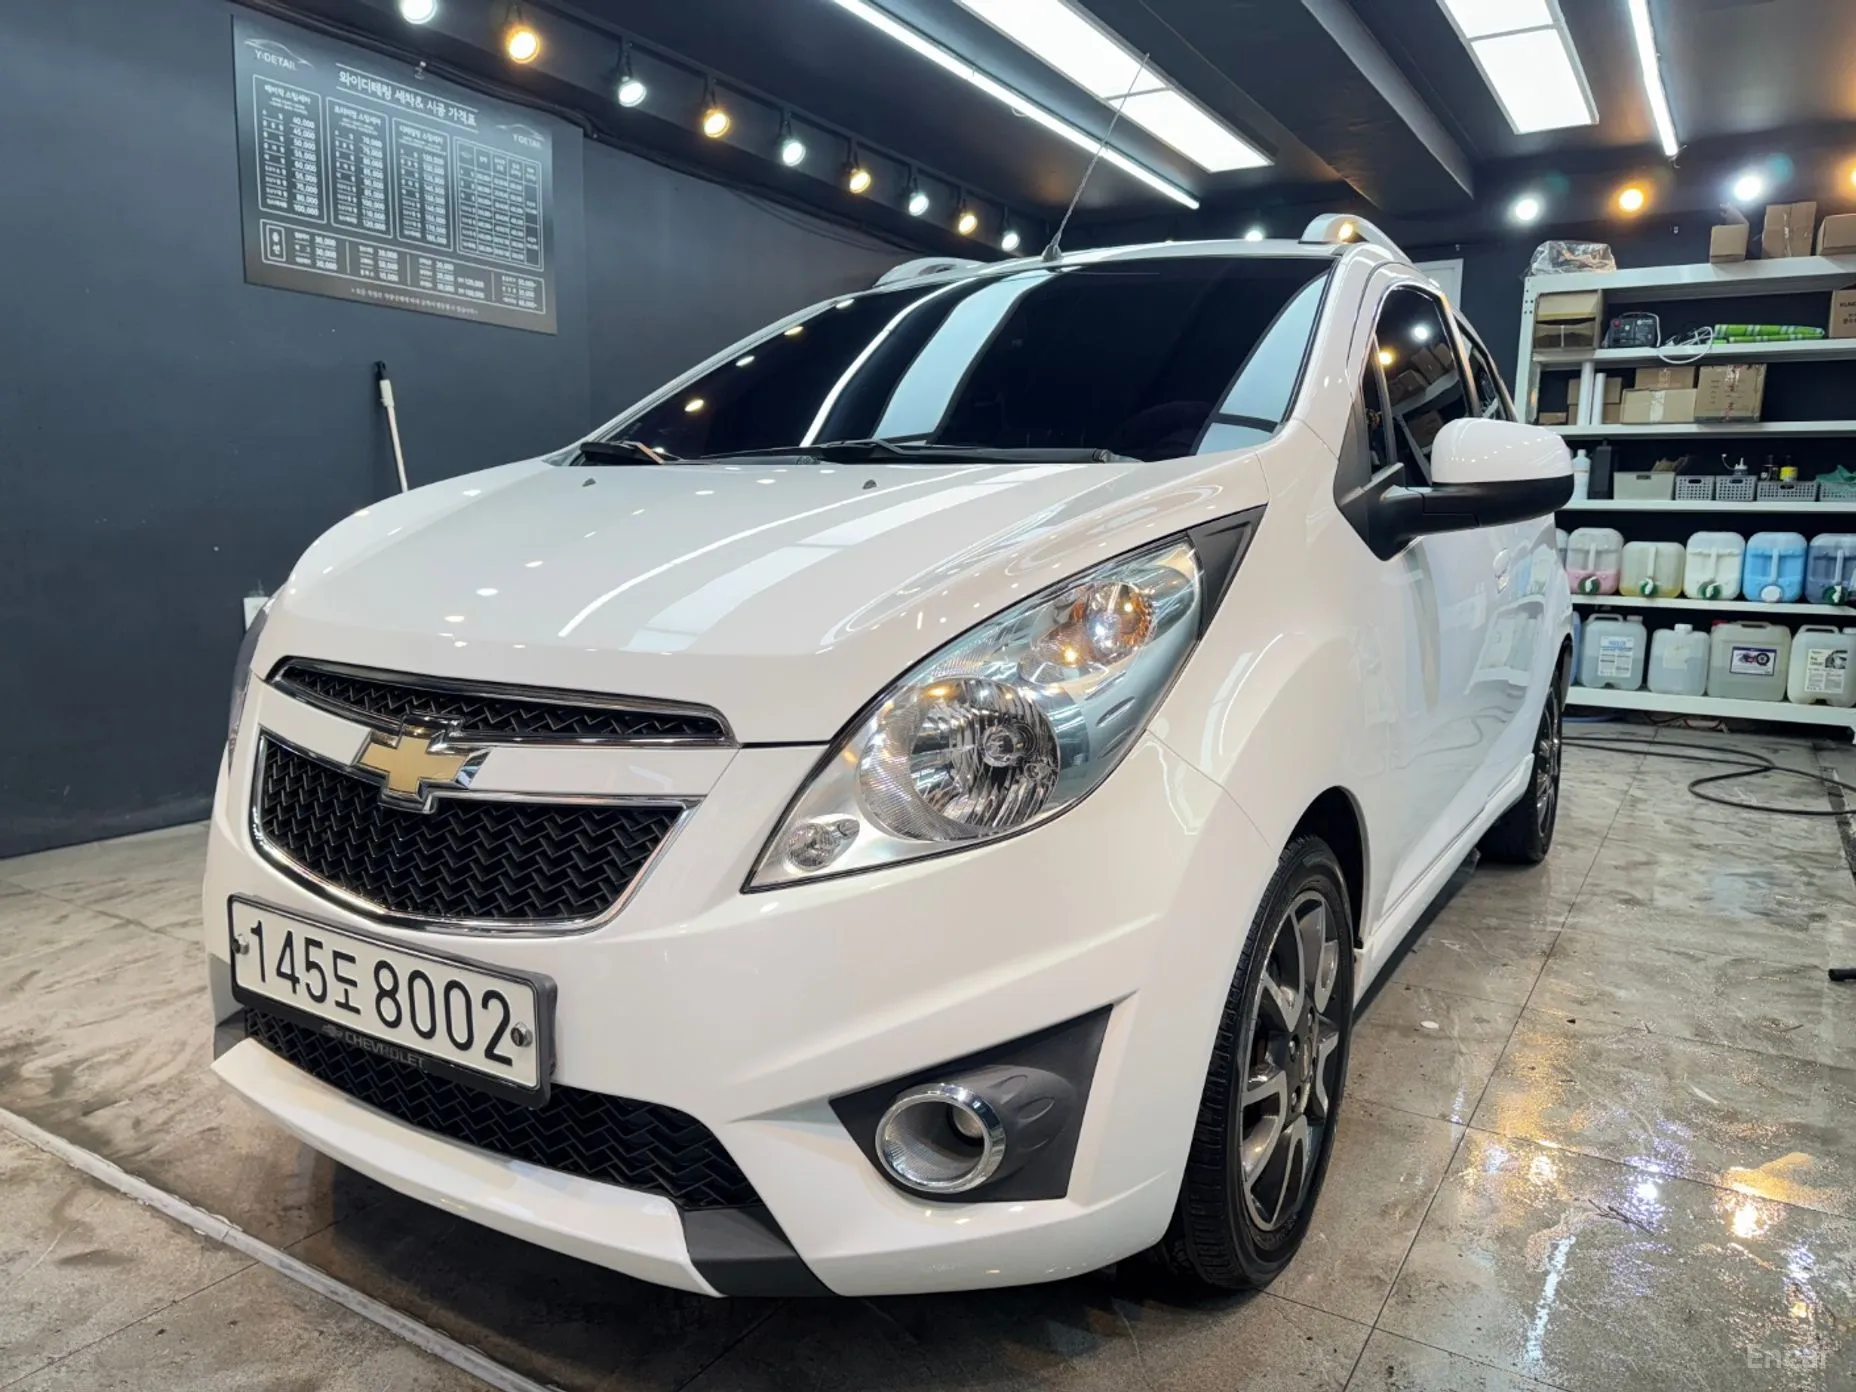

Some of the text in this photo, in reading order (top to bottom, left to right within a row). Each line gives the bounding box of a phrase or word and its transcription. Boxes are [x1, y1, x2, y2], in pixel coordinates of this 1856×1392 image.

[448, 107, 477, 127] 가격표
[250, 919, 514, 1067] 145도 8002
[344, 1033, 426, 1069] CHEVROLET
